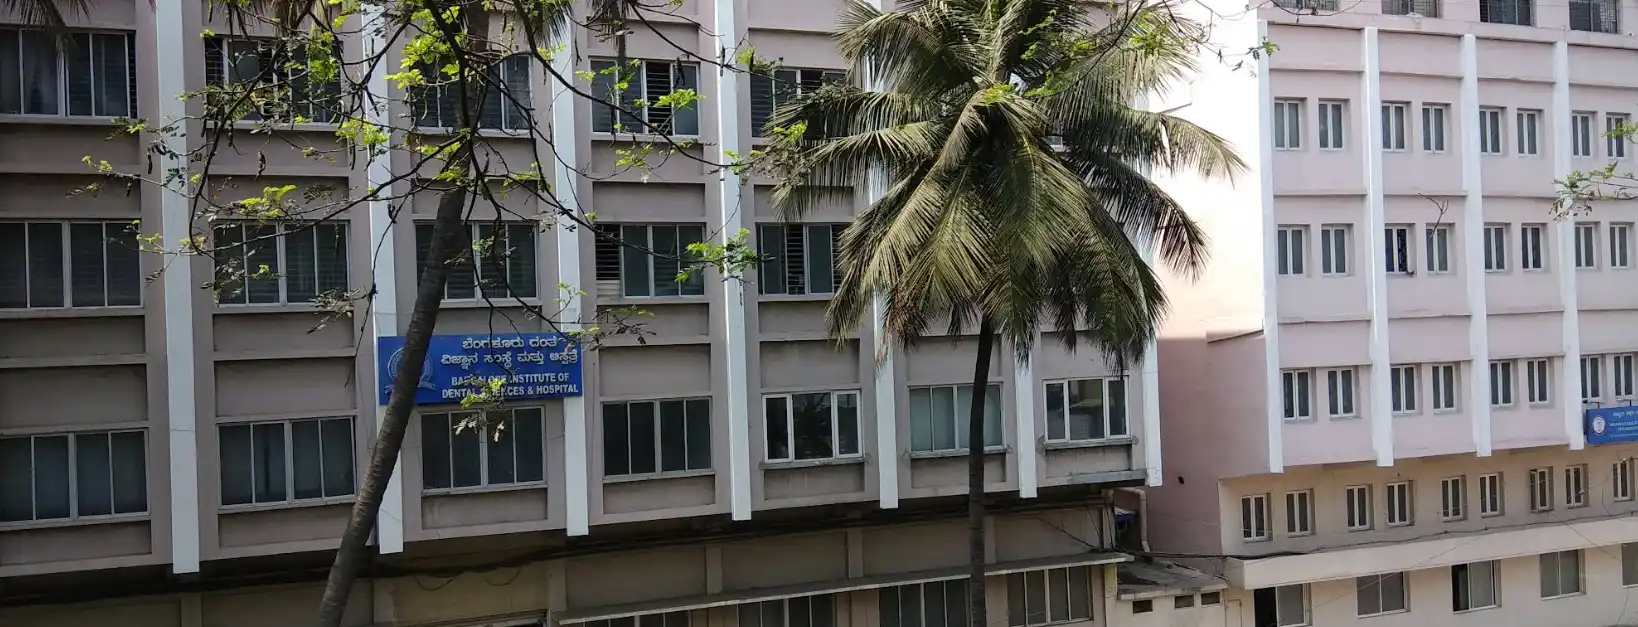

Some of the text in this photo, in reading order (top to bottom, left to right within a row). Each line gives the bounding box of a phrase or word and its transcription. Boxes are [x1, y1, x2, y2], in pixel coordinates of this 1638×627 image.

[517, 351, 544, 364] ಮತ್ತು
[509, 374, 556, 384] NSTITUTE
[557, 372, 569, 382] OF
[527, 385, 534, 395] &
[536, 384, 579, 395] HOSPITAL
